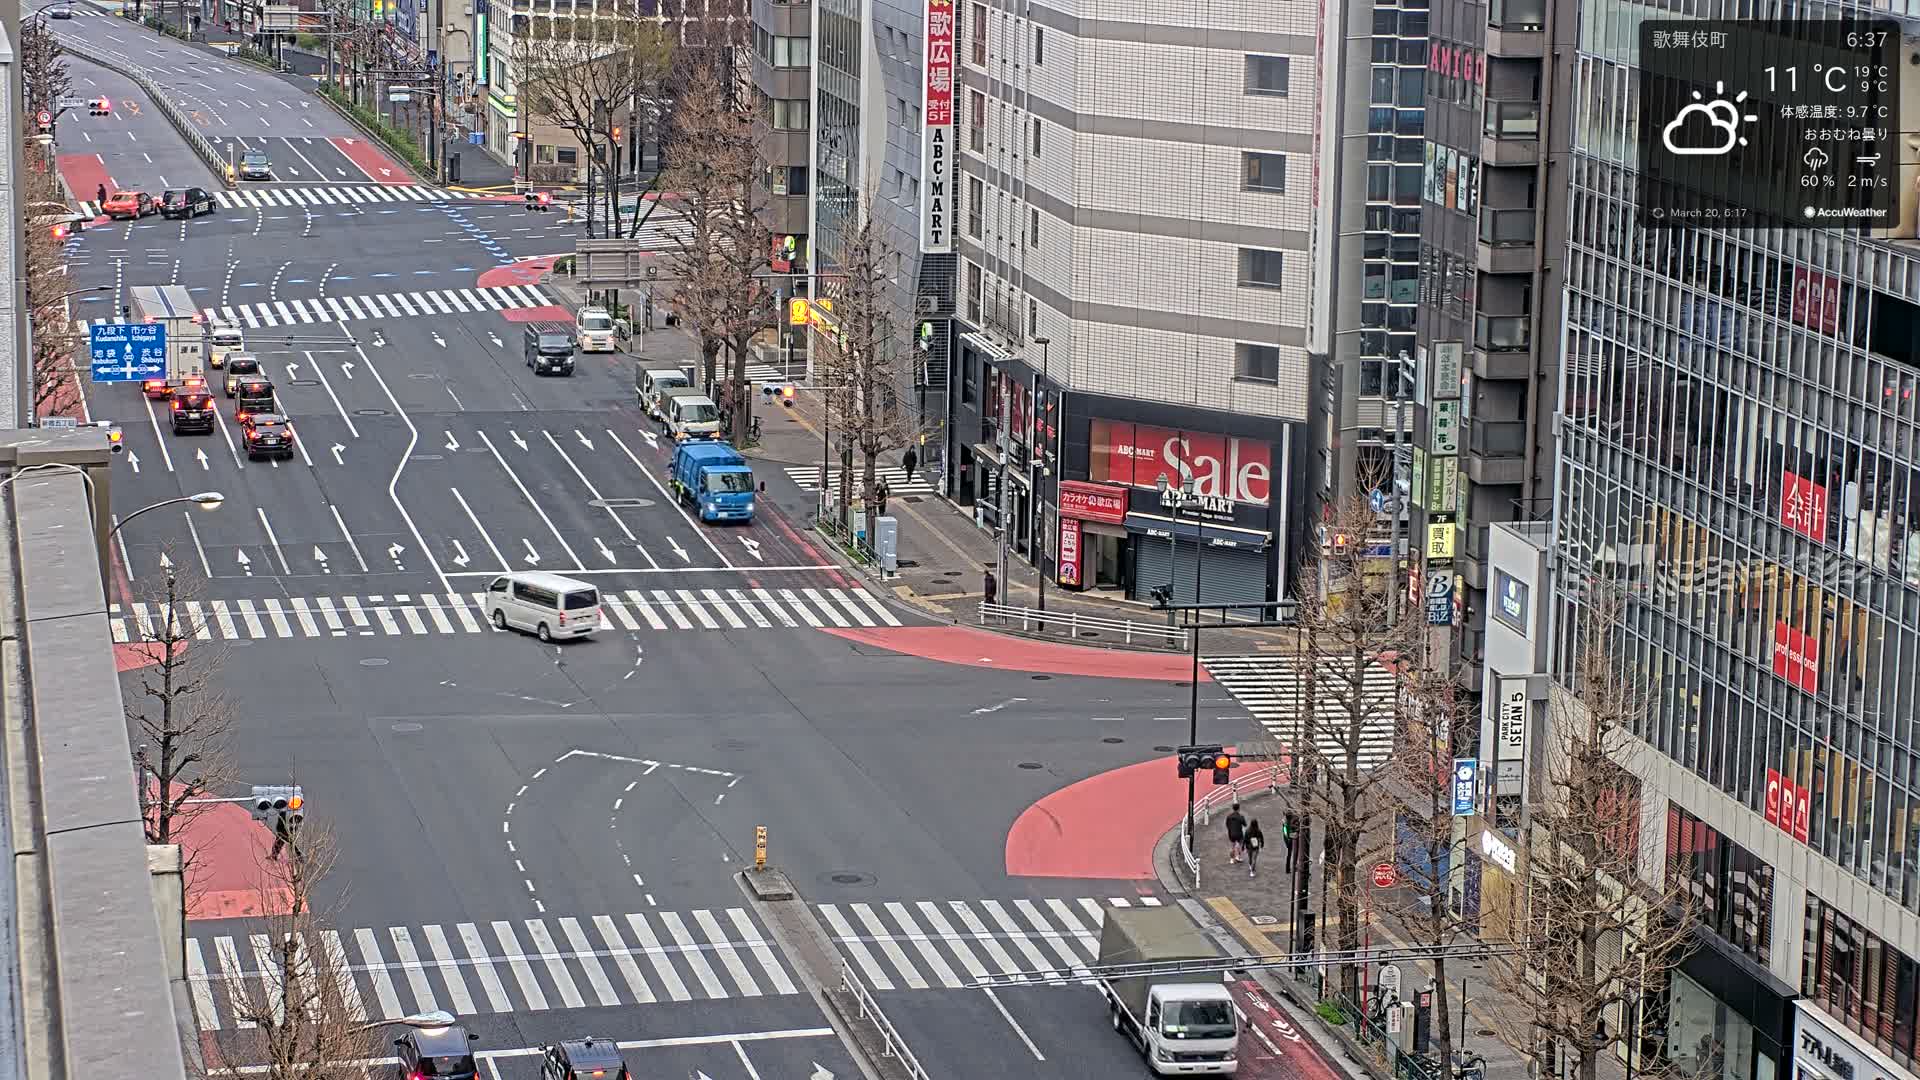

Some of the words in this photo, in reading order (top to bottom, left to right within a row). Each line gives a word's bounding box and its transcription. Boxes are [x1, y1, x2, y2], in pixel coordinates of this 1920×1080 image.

[929, 11, 951, 93] 歌広場
[1430, 42, 1484, 86] AMIGO
[928, 100, 951, 110] 受付
[928, 111, 950, 121] 5F
[932, 128, 944, 244] ABC-MART
[97, 326, 126, 335] 九段下
[141, 348, 163, 357] 渋谷
[1118, 445, 1154, 457] ABC-MART
[1163, 437, 1269, 506] Sale
[1062, 493, 1088, 504] カラオケ
[1097, 496, 1121, 509] 歌広場
[1787, 482, 1822, 532] 会計
[1437, 515, 1447, 523] 7F
[1432, 527, 1445, 554] 買取
[1511, 692, 1524, 702] 5
[1502, 702, 1510, 720] CITY
[1501, 722, 1509, 740] PARK
[1510, 706, 1522, 747] ISETAN
[1768, 780, 1807, 831] CPA
